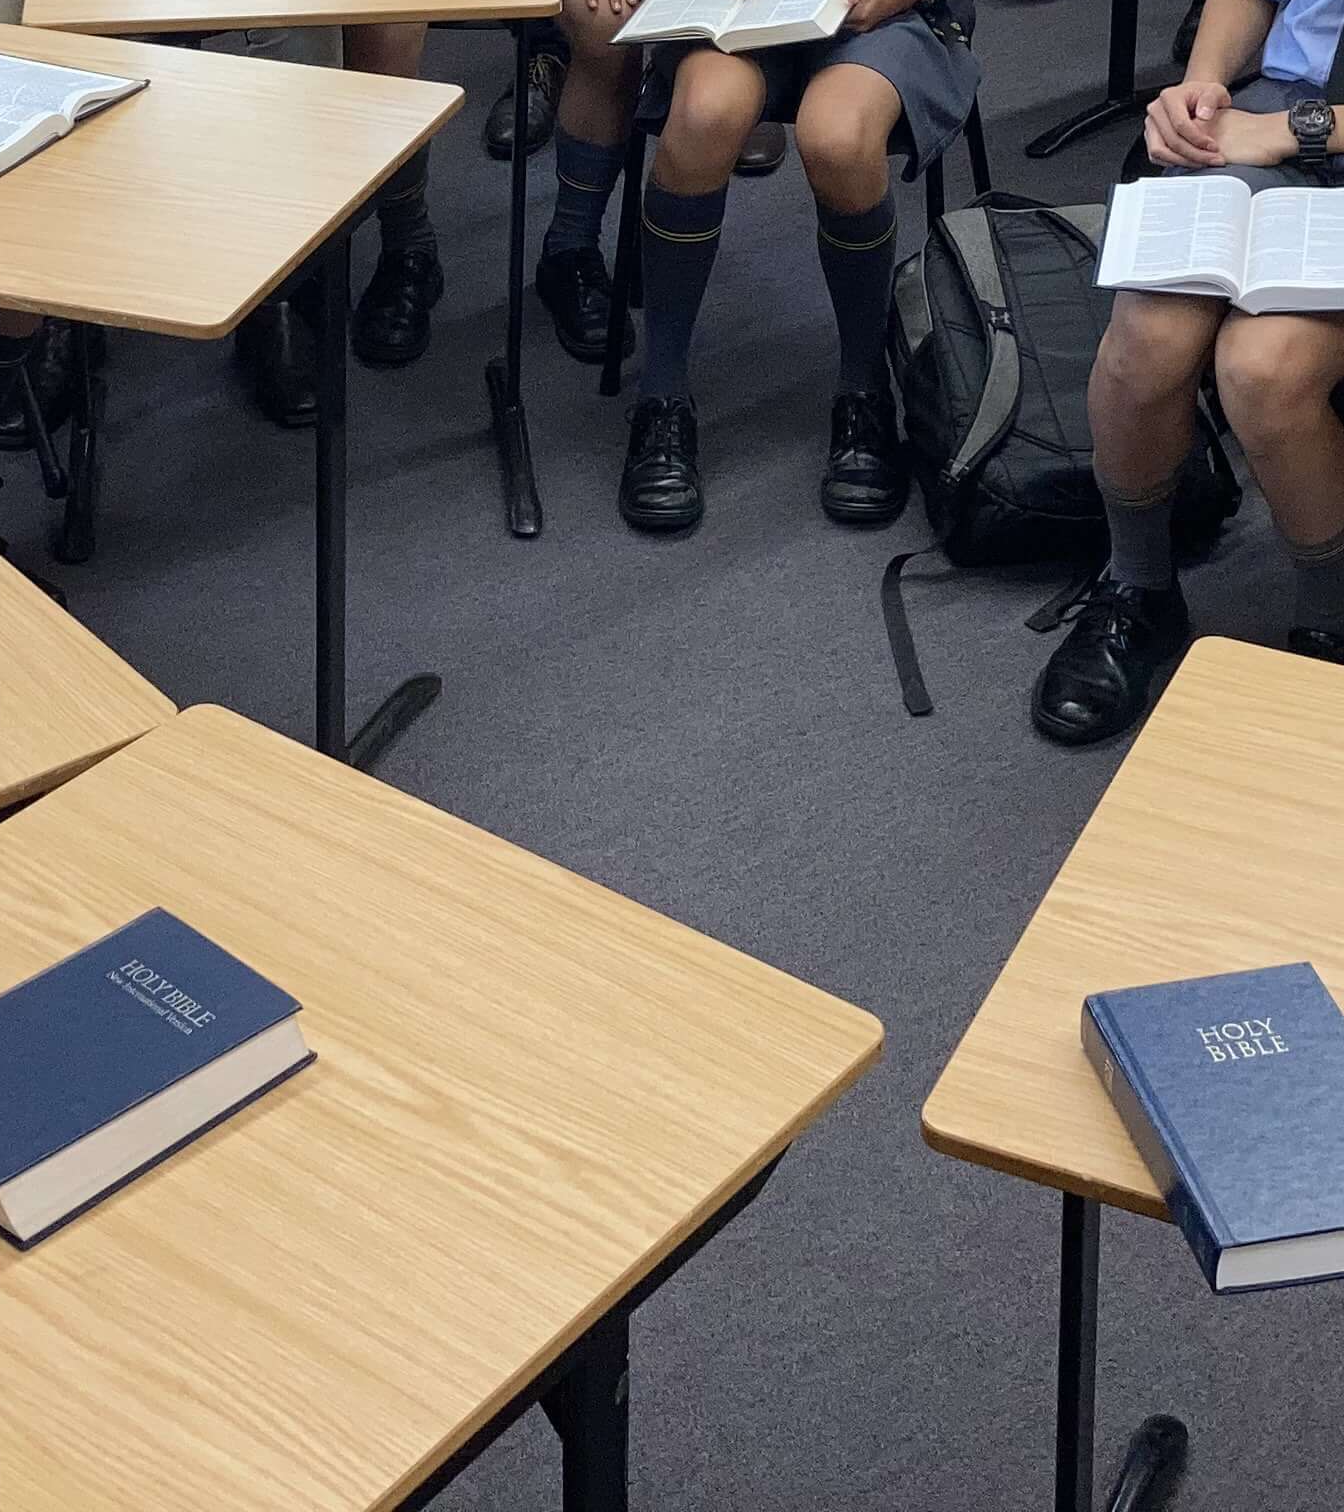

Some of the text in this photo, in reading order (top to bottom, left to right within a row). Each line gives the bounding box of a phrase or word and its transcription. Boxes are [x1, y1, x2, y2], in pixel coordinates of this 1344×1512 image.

[119, 959, 217, 1028] HOLY BIBLE
[1196, 1017, 1274, 1044] HOLY
[1205, 1035, 1289, 1063] BIBLE
